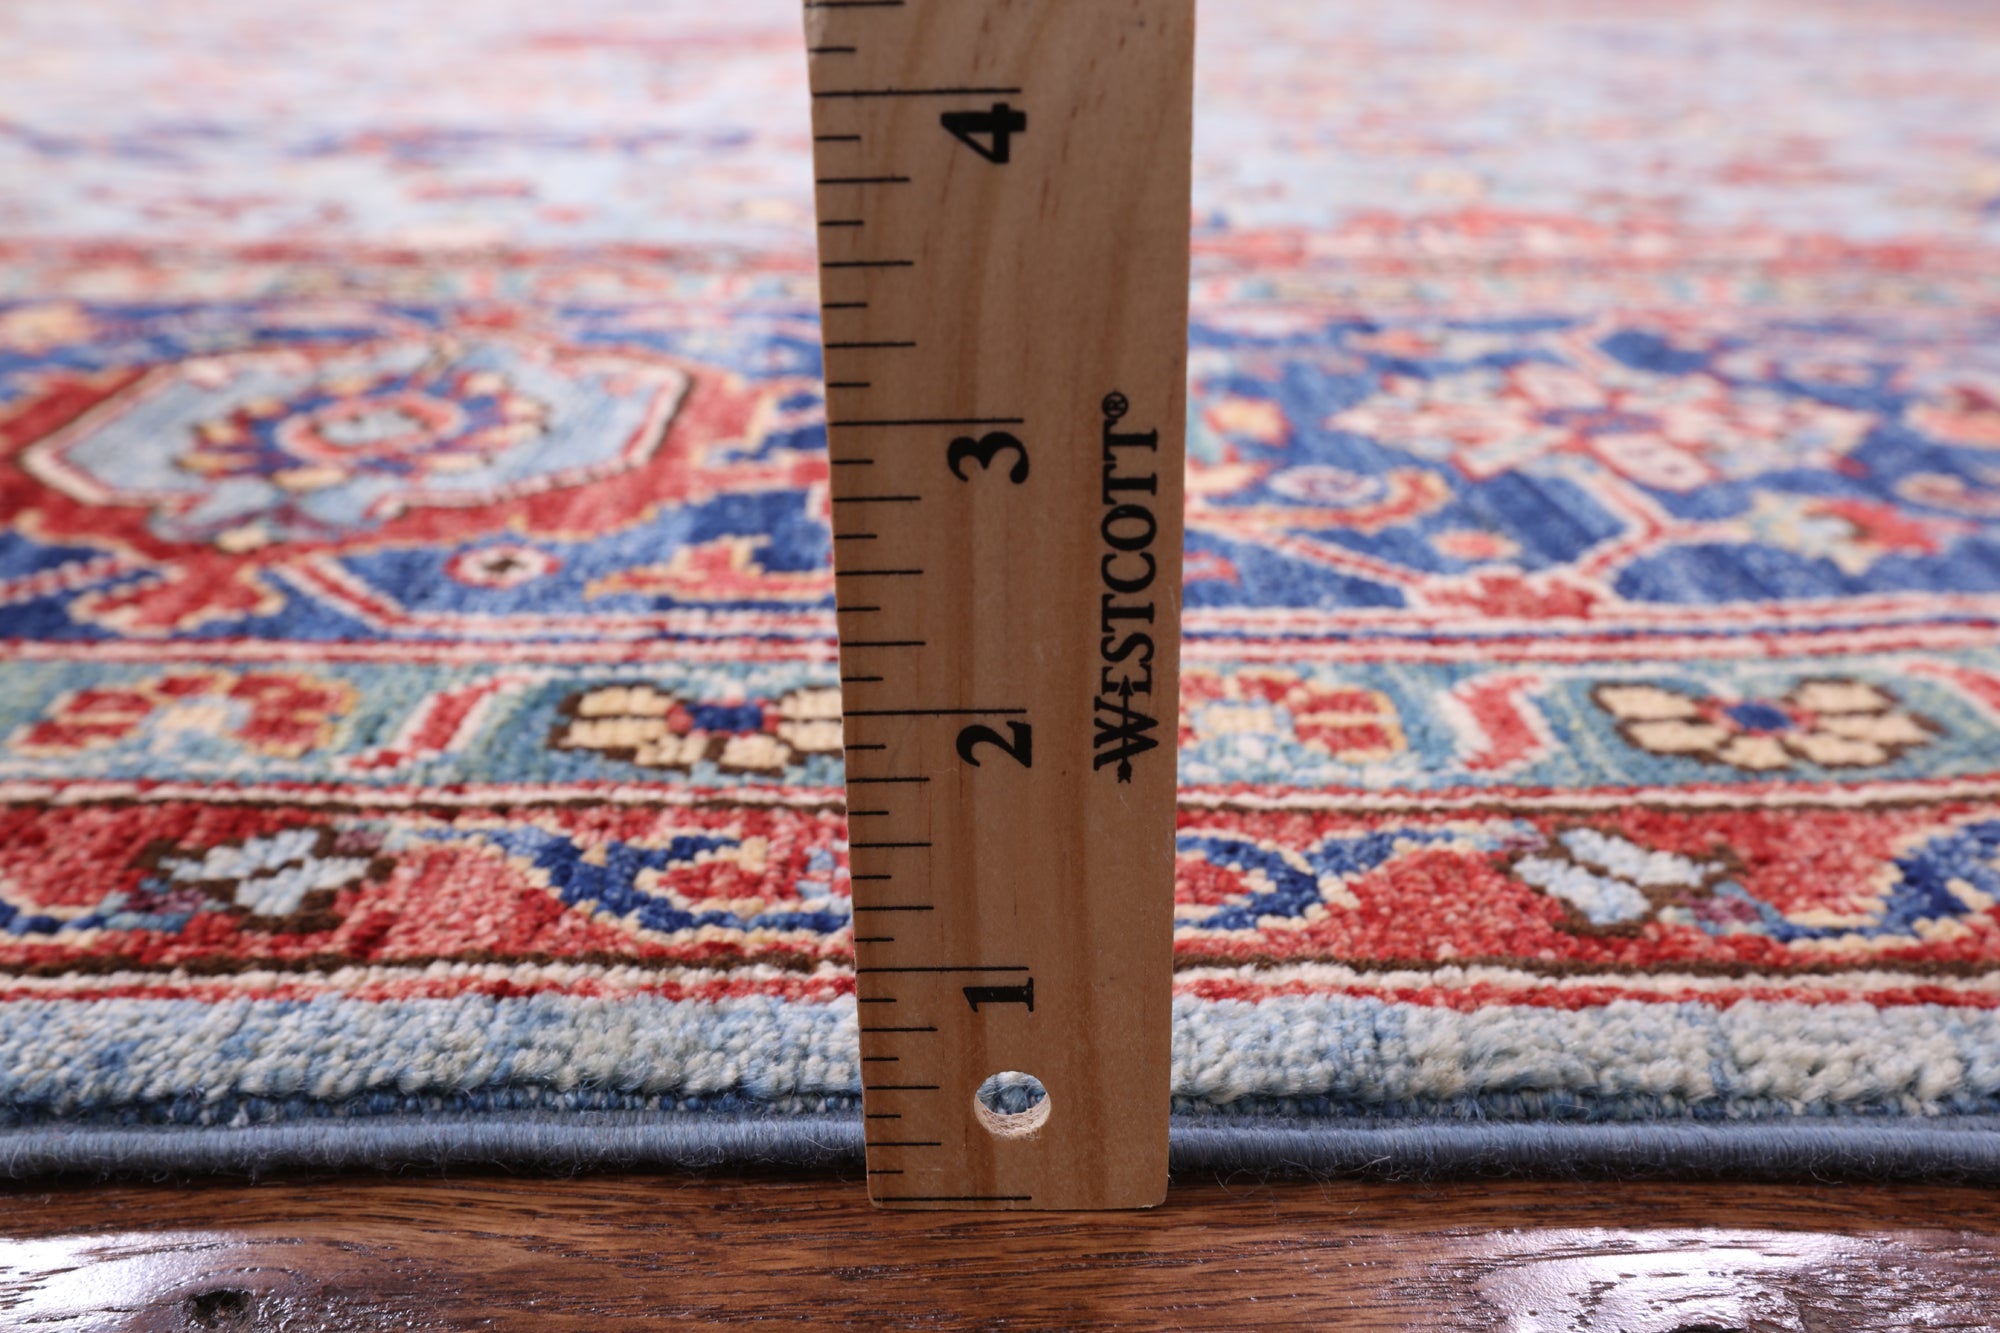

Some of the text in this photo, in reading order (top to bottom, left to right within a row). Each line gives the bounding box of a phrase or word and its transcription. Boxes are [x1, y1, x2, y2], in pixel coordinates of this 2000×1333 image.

[939, 102, 1027, 165] 4
[946, 430, 1030, 485] 3
[955, 719, 1033, 769] 2
[962, 976, 1035, 1013] 1
